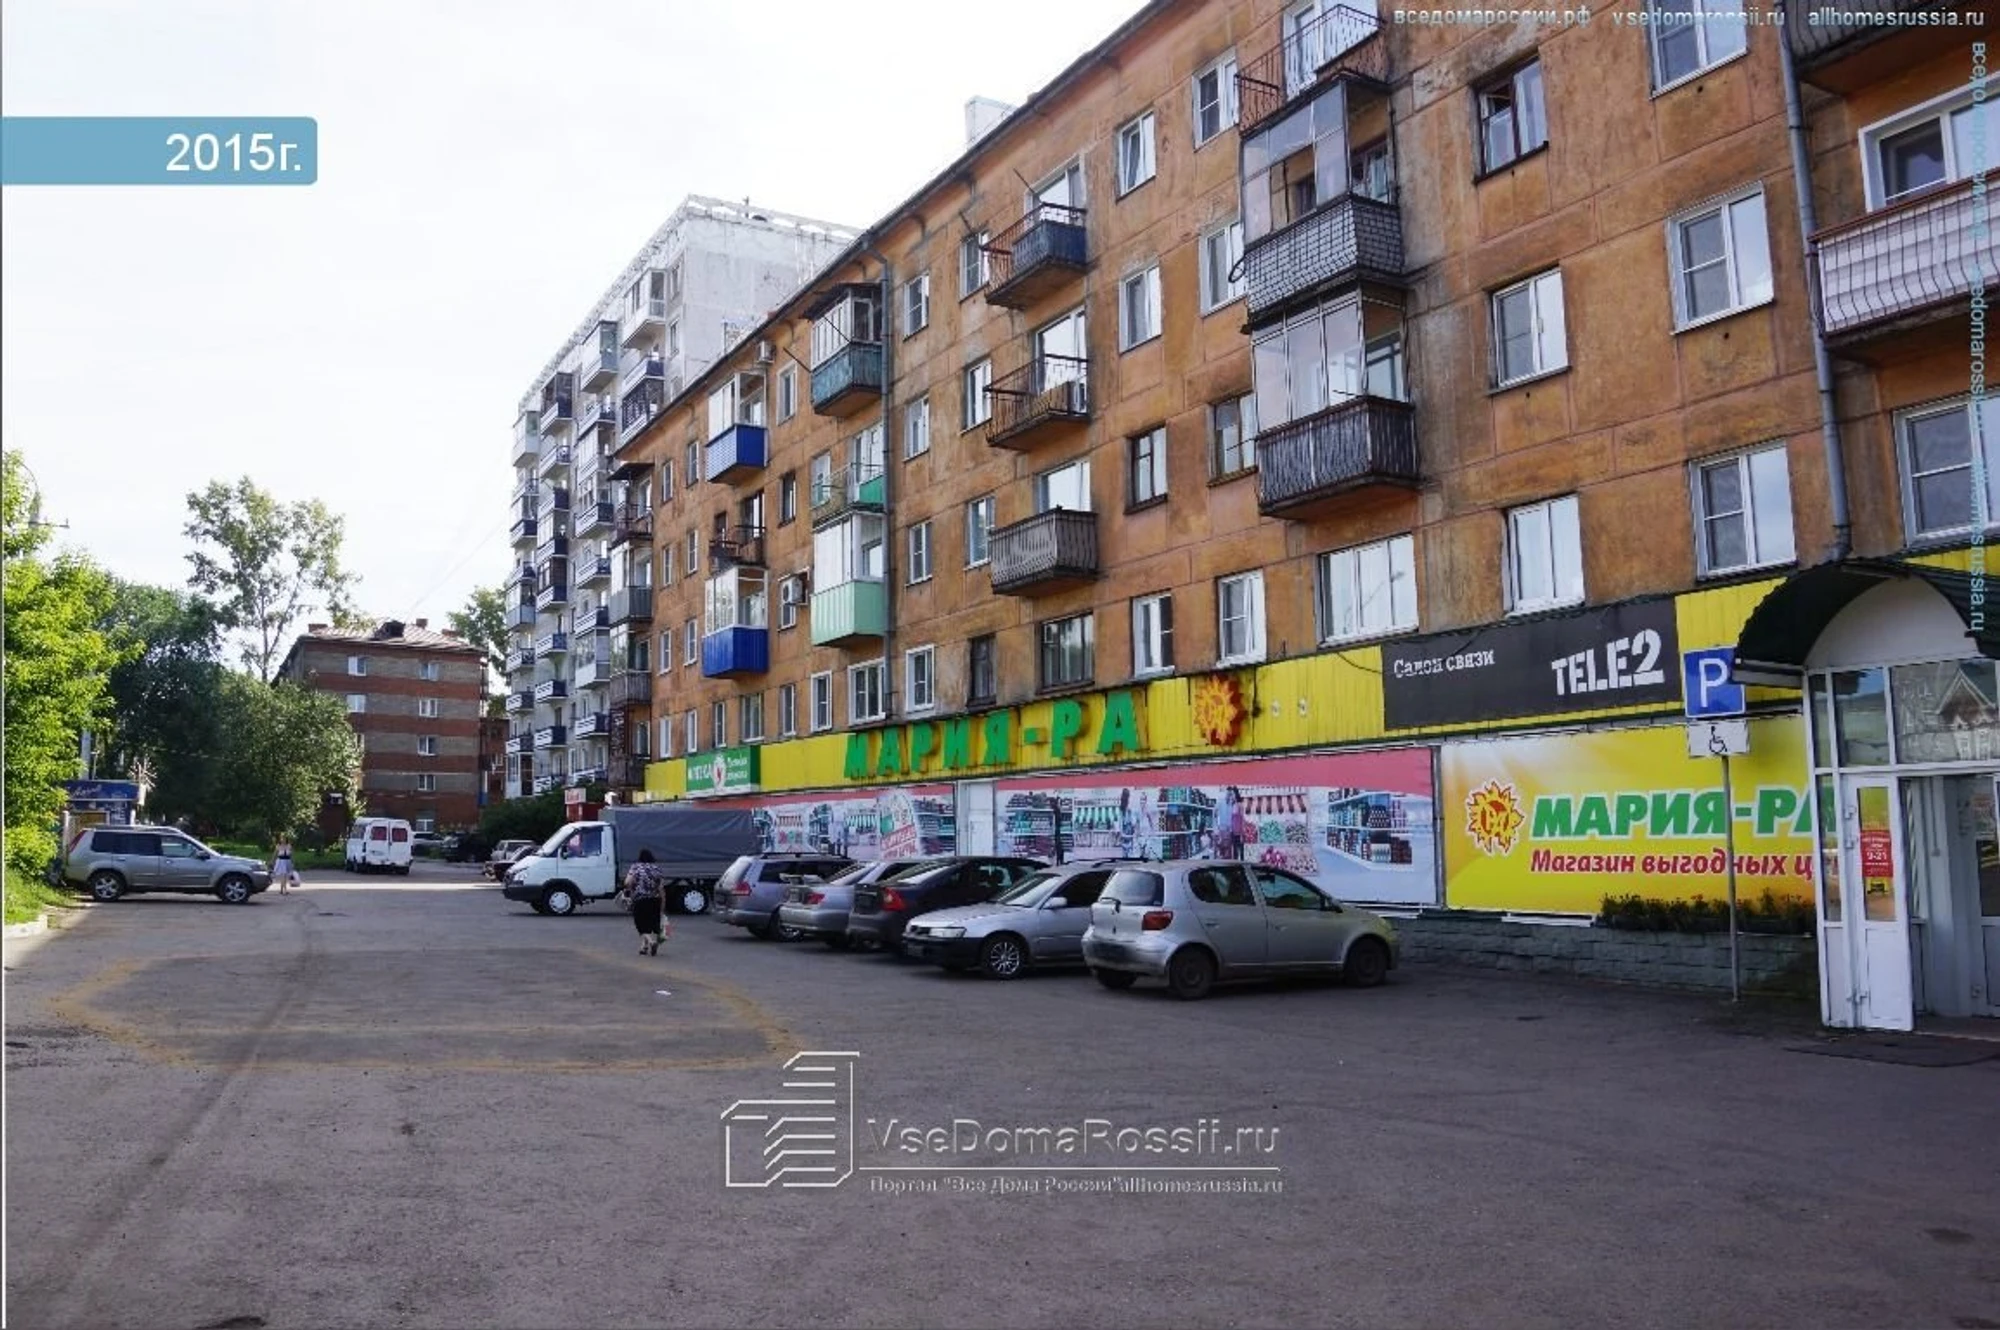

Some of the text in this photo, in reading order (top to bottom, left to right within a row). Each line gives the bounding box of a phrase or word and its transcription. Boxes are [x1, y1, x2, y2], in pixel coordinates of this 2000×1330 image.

[1393, 649, 1496, 678] Салон связи
[1551, 629, 1664, 696] TELE2
[844, 692, 1138, 779] МАРИЯ-РА
[1531, 850, 1635, 873] Магазин
[1642, 848, 1787, 875] выгодных
